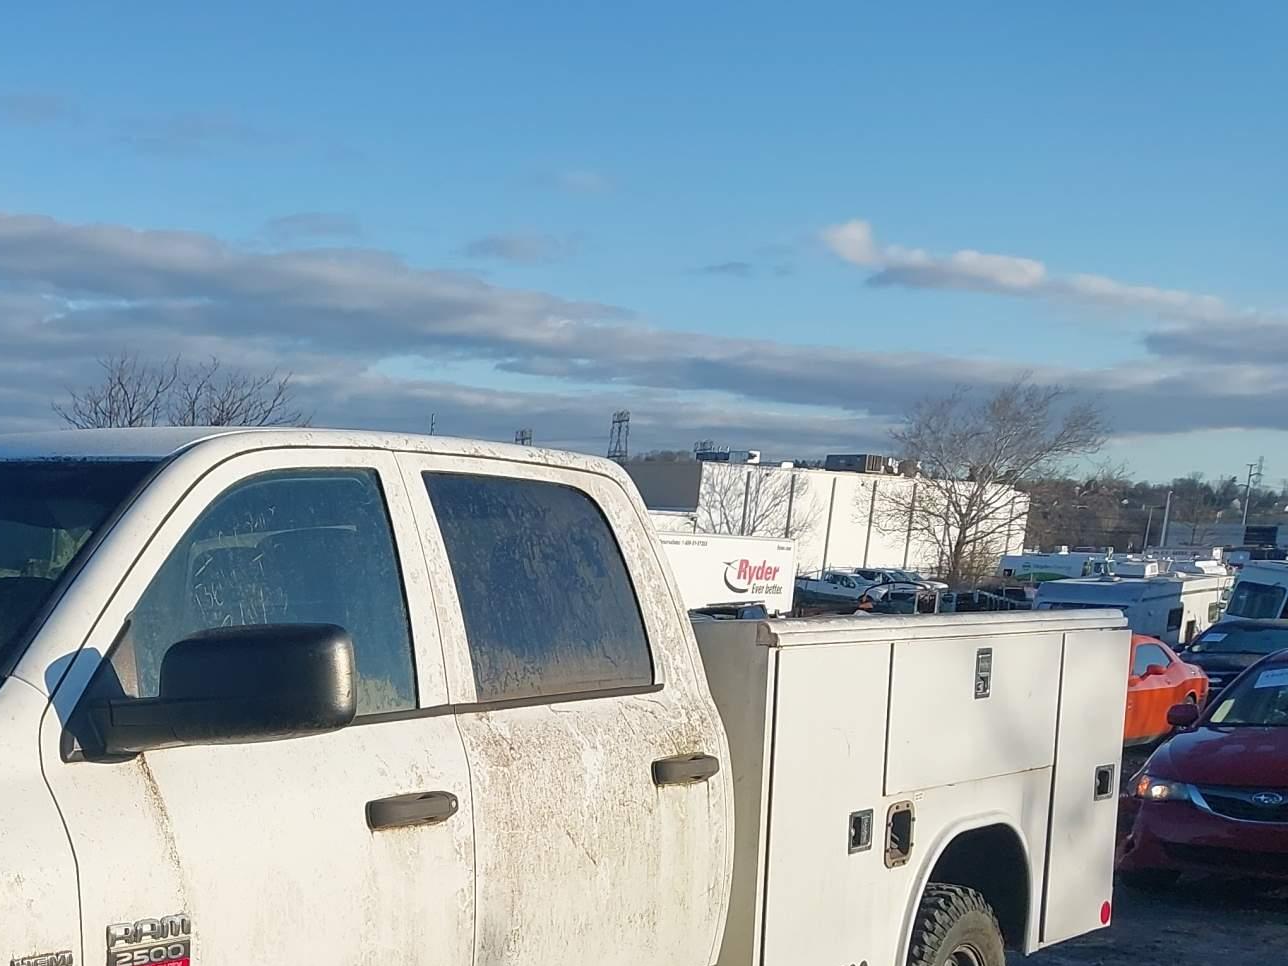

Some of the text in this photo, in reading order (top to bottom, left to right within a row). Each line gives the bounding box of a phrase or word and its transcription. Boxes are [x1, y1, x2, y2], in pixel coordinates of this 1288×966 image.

[737, 559, 780, 585] Ryder
[751, 584, 764, 594] Ever
[107, 913, 191, 947] RAM
